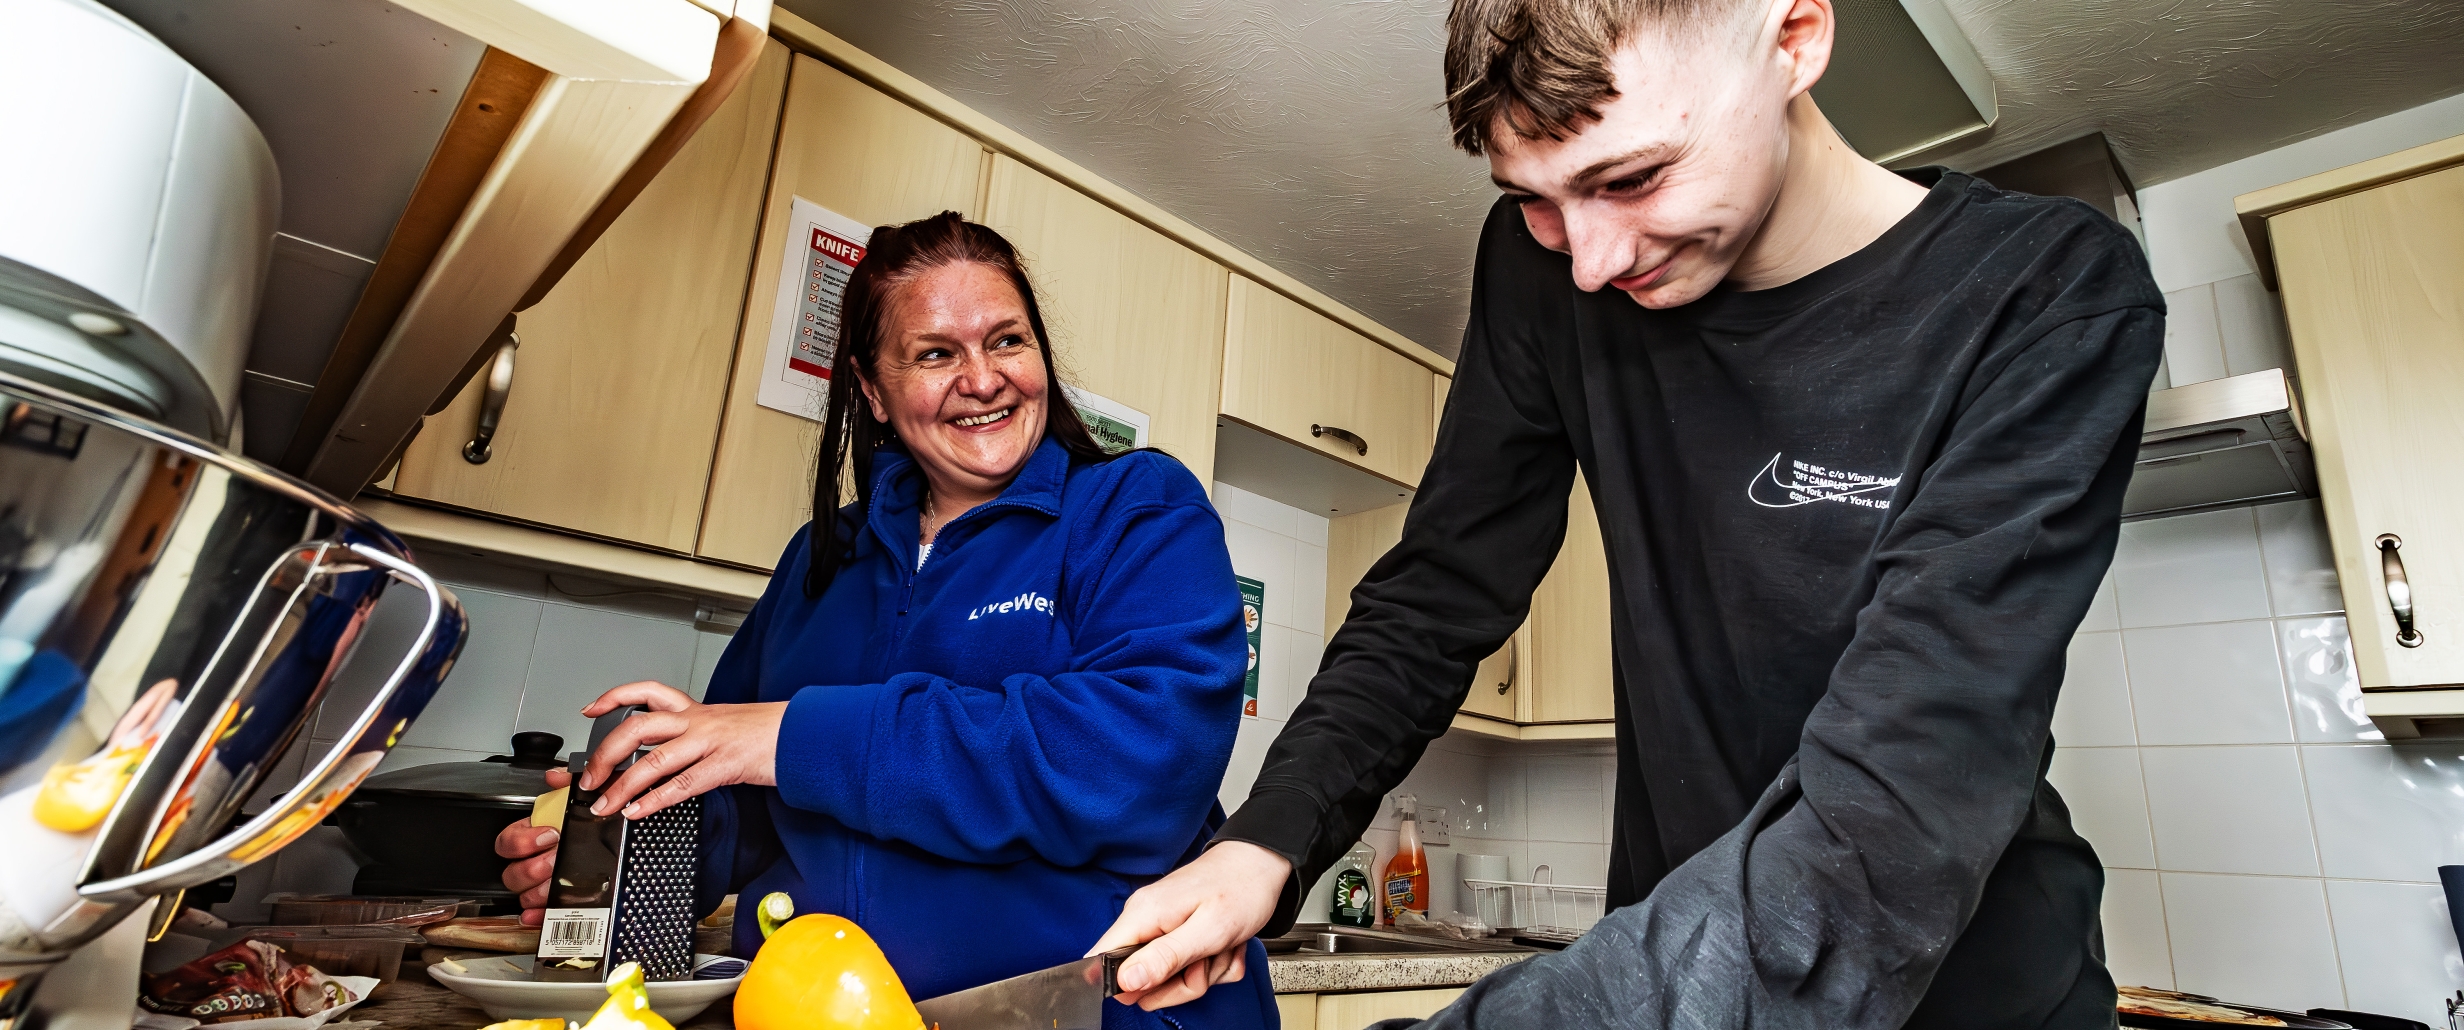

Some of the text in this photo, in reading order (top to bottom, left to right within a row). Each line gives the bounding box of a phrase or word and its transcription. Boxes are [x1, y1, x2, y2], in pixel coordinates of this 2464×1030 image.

[815, 234, 860, 262] KNIFE
[1100, 427, 1133, 447] Hygiene
[1793, 460, 1809, 472] NIKE
[1810, 465, 1827, 477] INC.
[1828, 470, 1845, 479] c/o
[1847, 472, 1874, 484] Virgil
[1793, 470, 1853, 491] "OFF CAMPUS"
[1792, 481, 1806, 493] New
[1826, 490, 1847, 503] New
[1850, 495, 1873, 508] York
[967, 591, 1055, 620] LiveWes
[1241, 592, 1260, 603] HING
